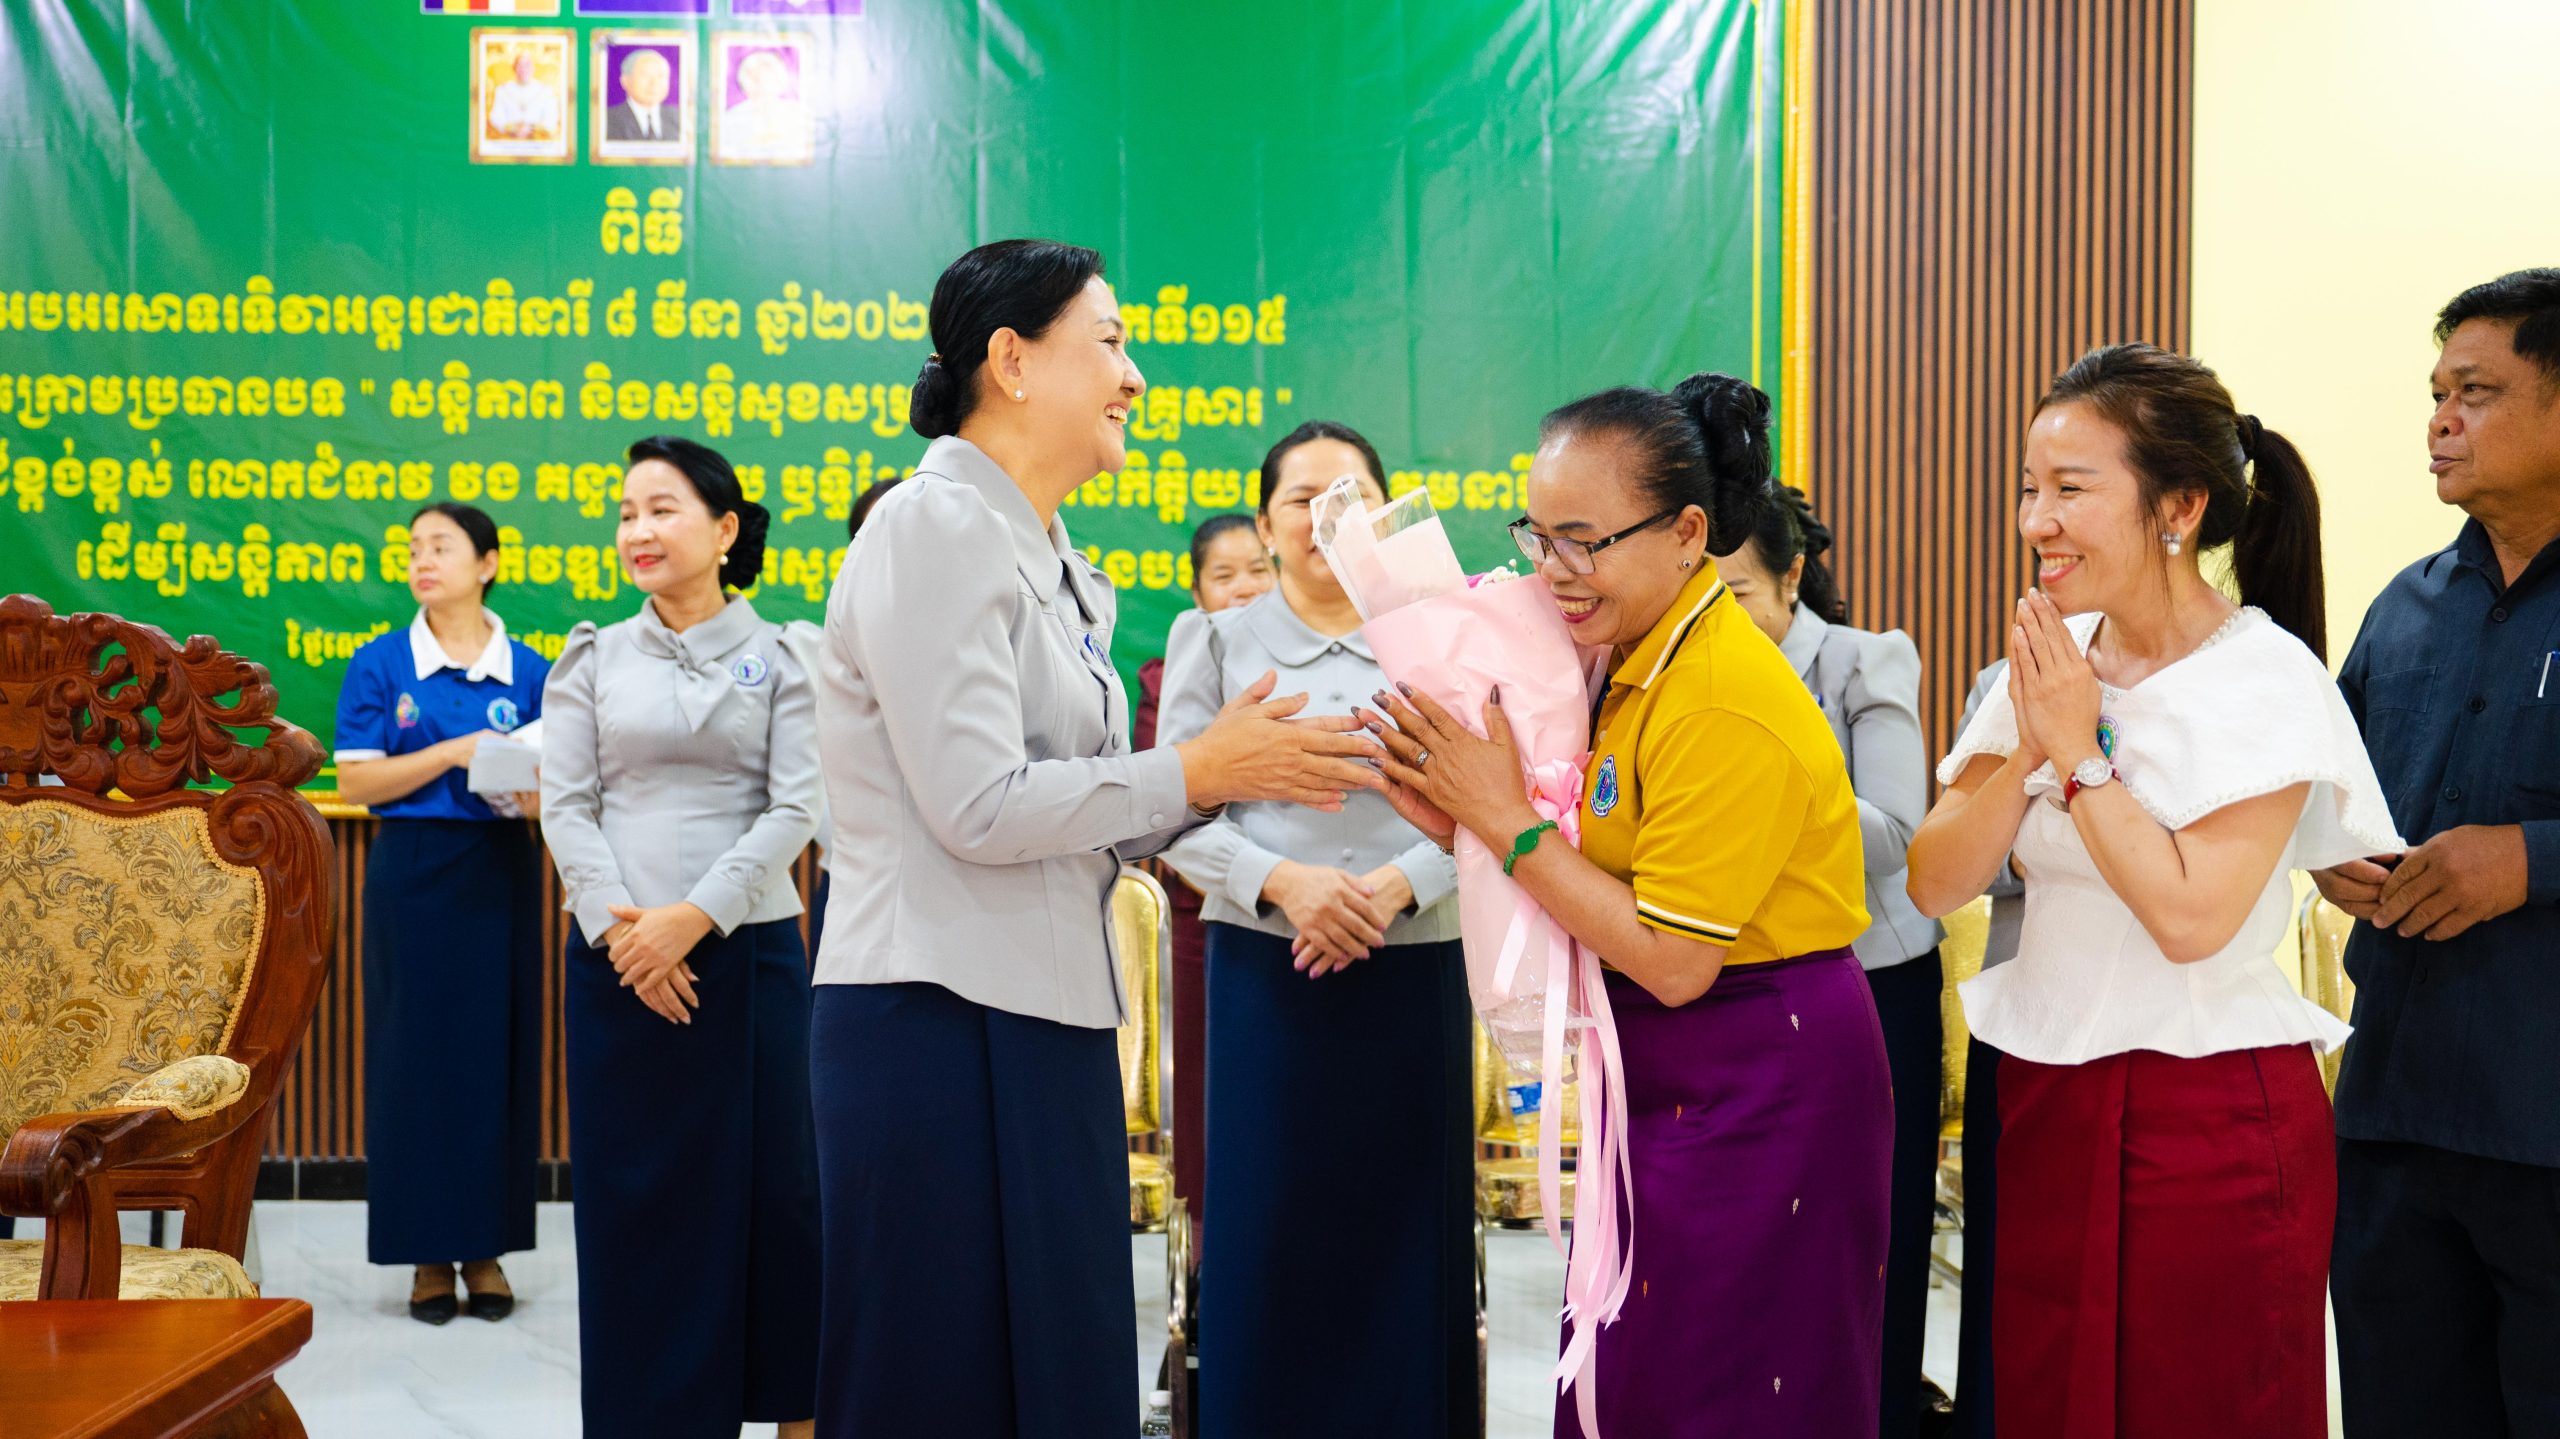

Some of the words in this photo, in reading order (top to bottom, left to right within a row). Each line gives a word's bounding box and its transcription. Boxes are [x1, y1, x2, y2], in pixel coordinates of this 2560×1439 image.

[602, 187, 683, 255] ពិធី
[607, 288, 637, 337] ៨
[652, 280, 741, 339] មីនា
[756, 281, 930, 355] ឆ្នាំ២០២
[390, 360, 565, 435] សន្តិភាព
[0, 438, 173, 514] ខ្ពង់ខ្ពស់
[188, 441, 433, 500] លោកជំទាវ
[448, 461, 521, 502] វង
[535, 462, 624, 518] គន្ធា
[77, 521, 365, 598] ដើម្បីសន្តិភាព
